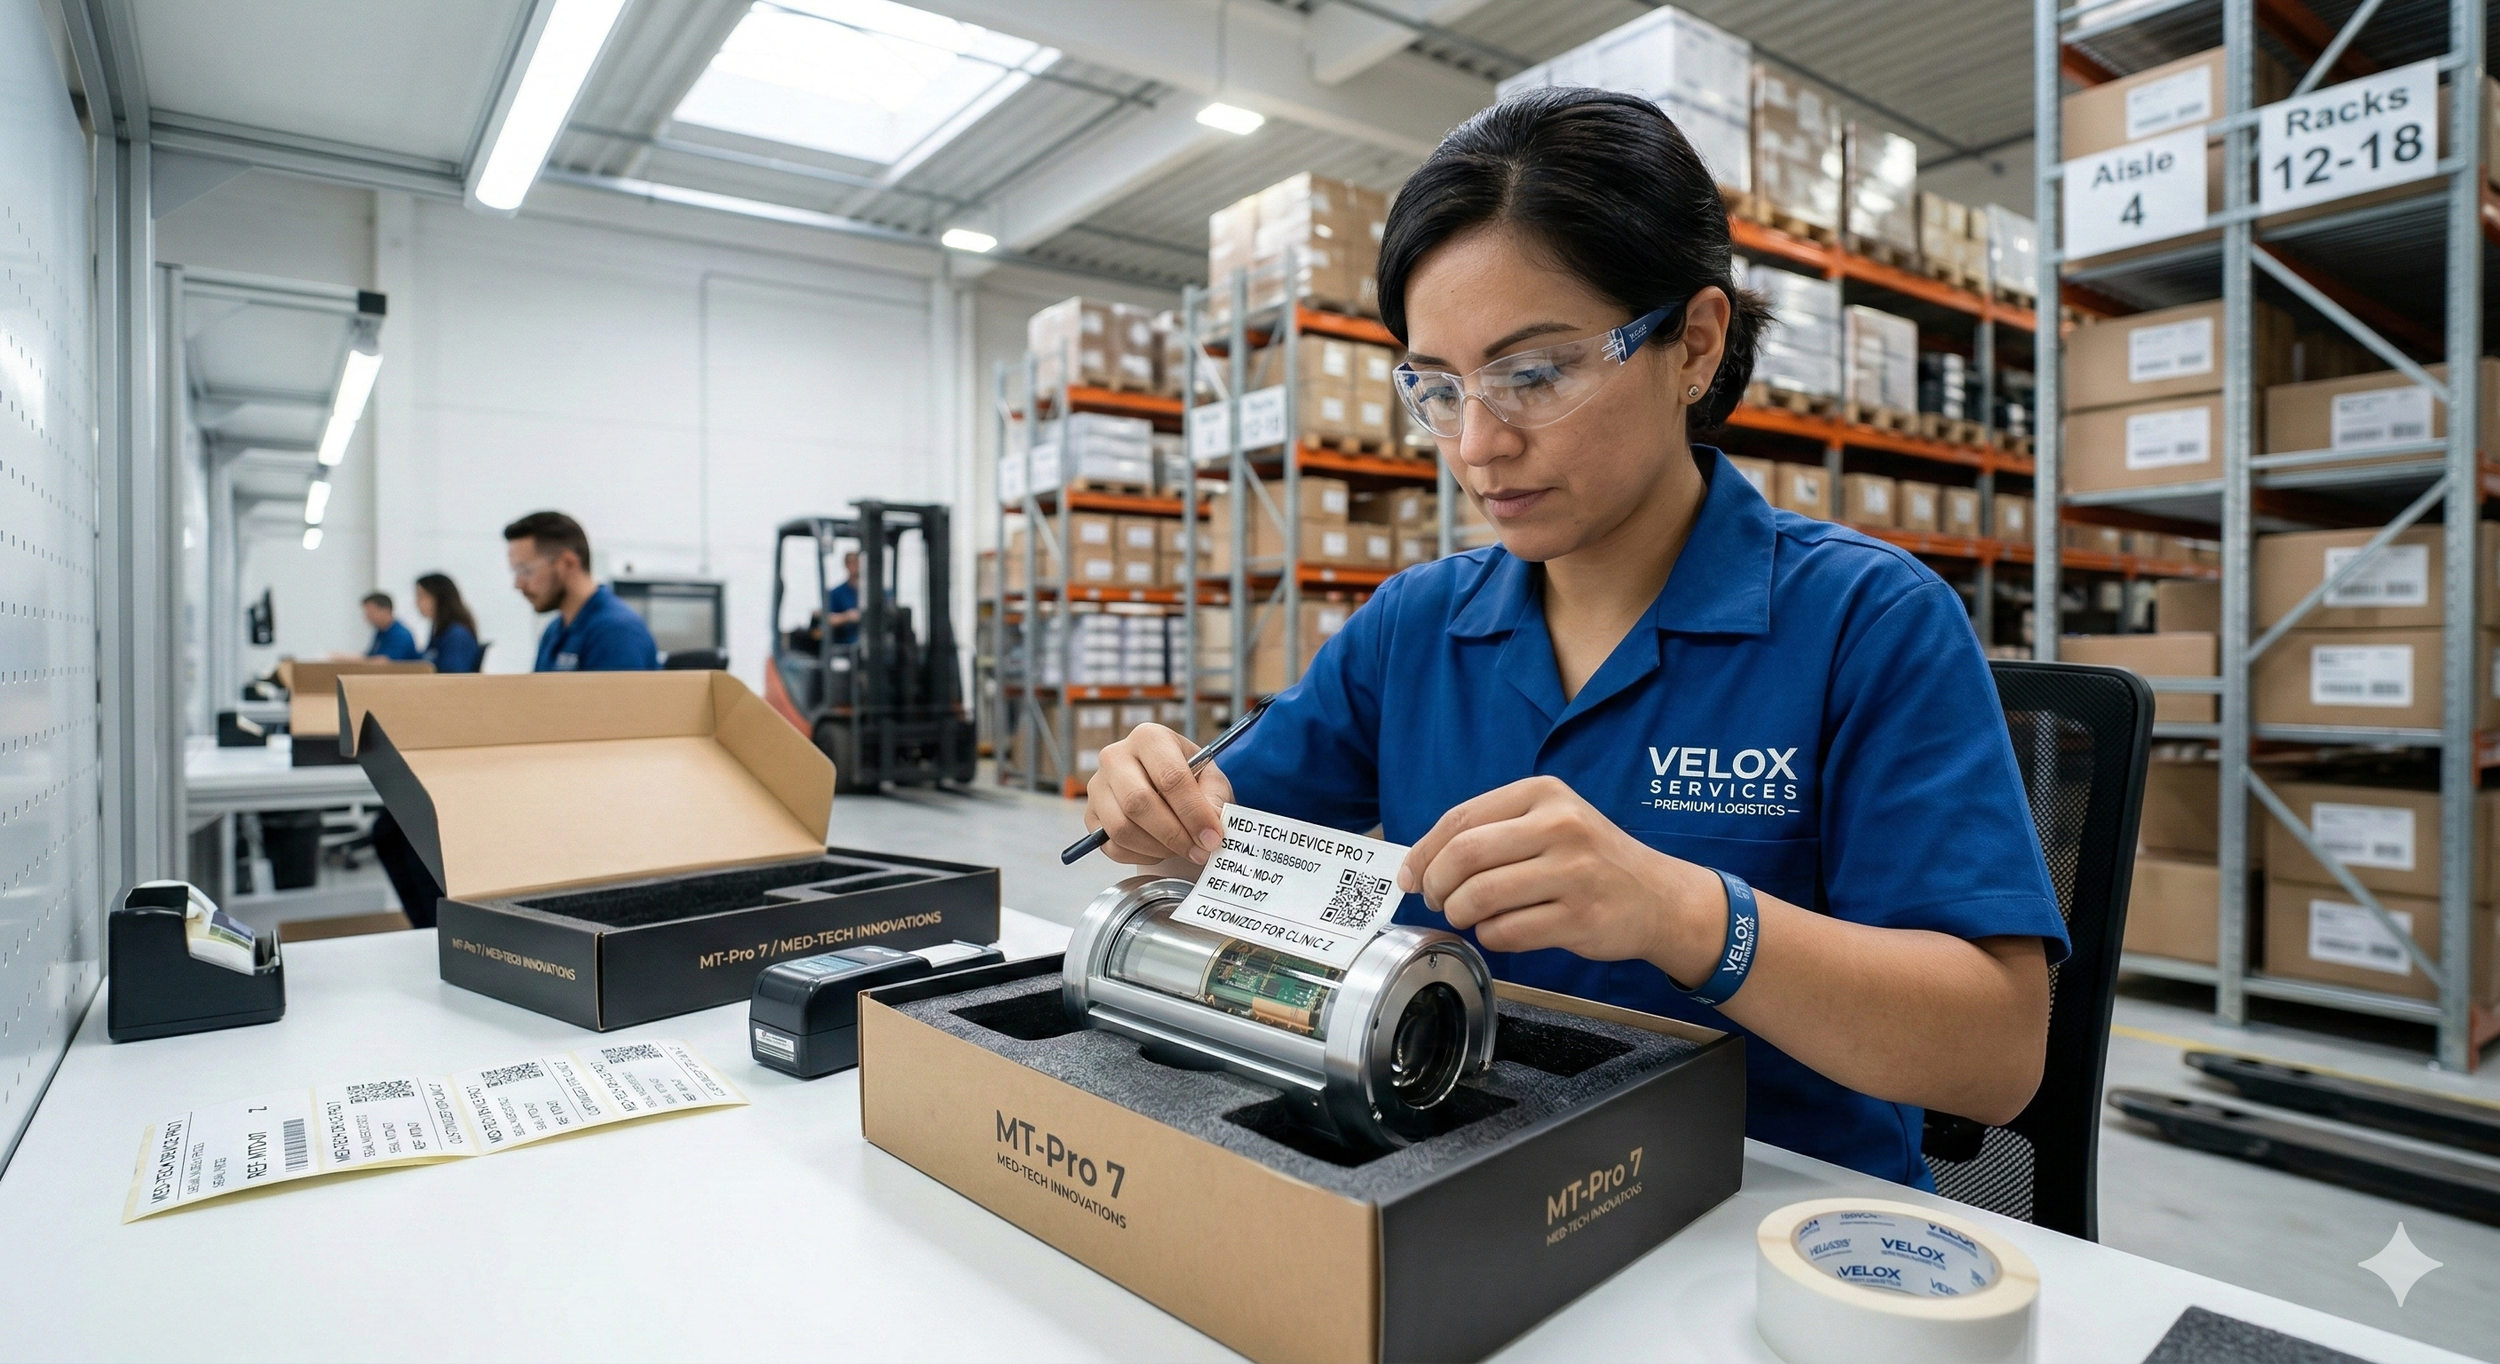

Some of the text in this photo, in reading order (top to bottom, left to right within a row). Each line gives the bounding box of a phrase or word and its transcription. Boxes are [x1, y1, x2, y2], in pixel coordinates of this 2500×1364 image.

[2285, 84, 2410, 139] Racks
[2092, 149, 2176, 188] Aisle
[2273, 122, 2424, 191] 12-18
[2120, 192, 2146, 226] 4
[1648, 746, 1798, 780] VELOX
[1650, 779, 1797, 800] SERVICES
[1654, 799, 1786, 816] PREMIUM LOGISTICS
[1221, 837, 1260, 858] SERIAL:
[1227, 816, 1375, 864] MED-TECH DEVICE PRO 7
[1214, 857, 1253, 877] SERIAL:
[1229, 882, 1269, 902] MTD-07
[699, 947, 755, 969] MT-Pro
[758, 943, 768, 958] 7
[780, 927, 854, 953] MED-TECH
[857, 911, 942, 939] INNOVATIONS
[1196, 904, 1335, 951] CUSTOMIZED FOR CLINIC Z
[1722, 913, 1750, 972] VELOX
[523, 956, 576, 981] INNOVATIONS
[996, 1109, 1126, 1199] MT-Pro 7
[997, 1152, 1127, 1229] MED-TECH INNOVATIONS
[1547, 1146, 1643, 1226] MT-Pro 7
[1881, 1237, 1946, 1264] VELOX
[1839, 1265, 1901, 1280] VELOX
